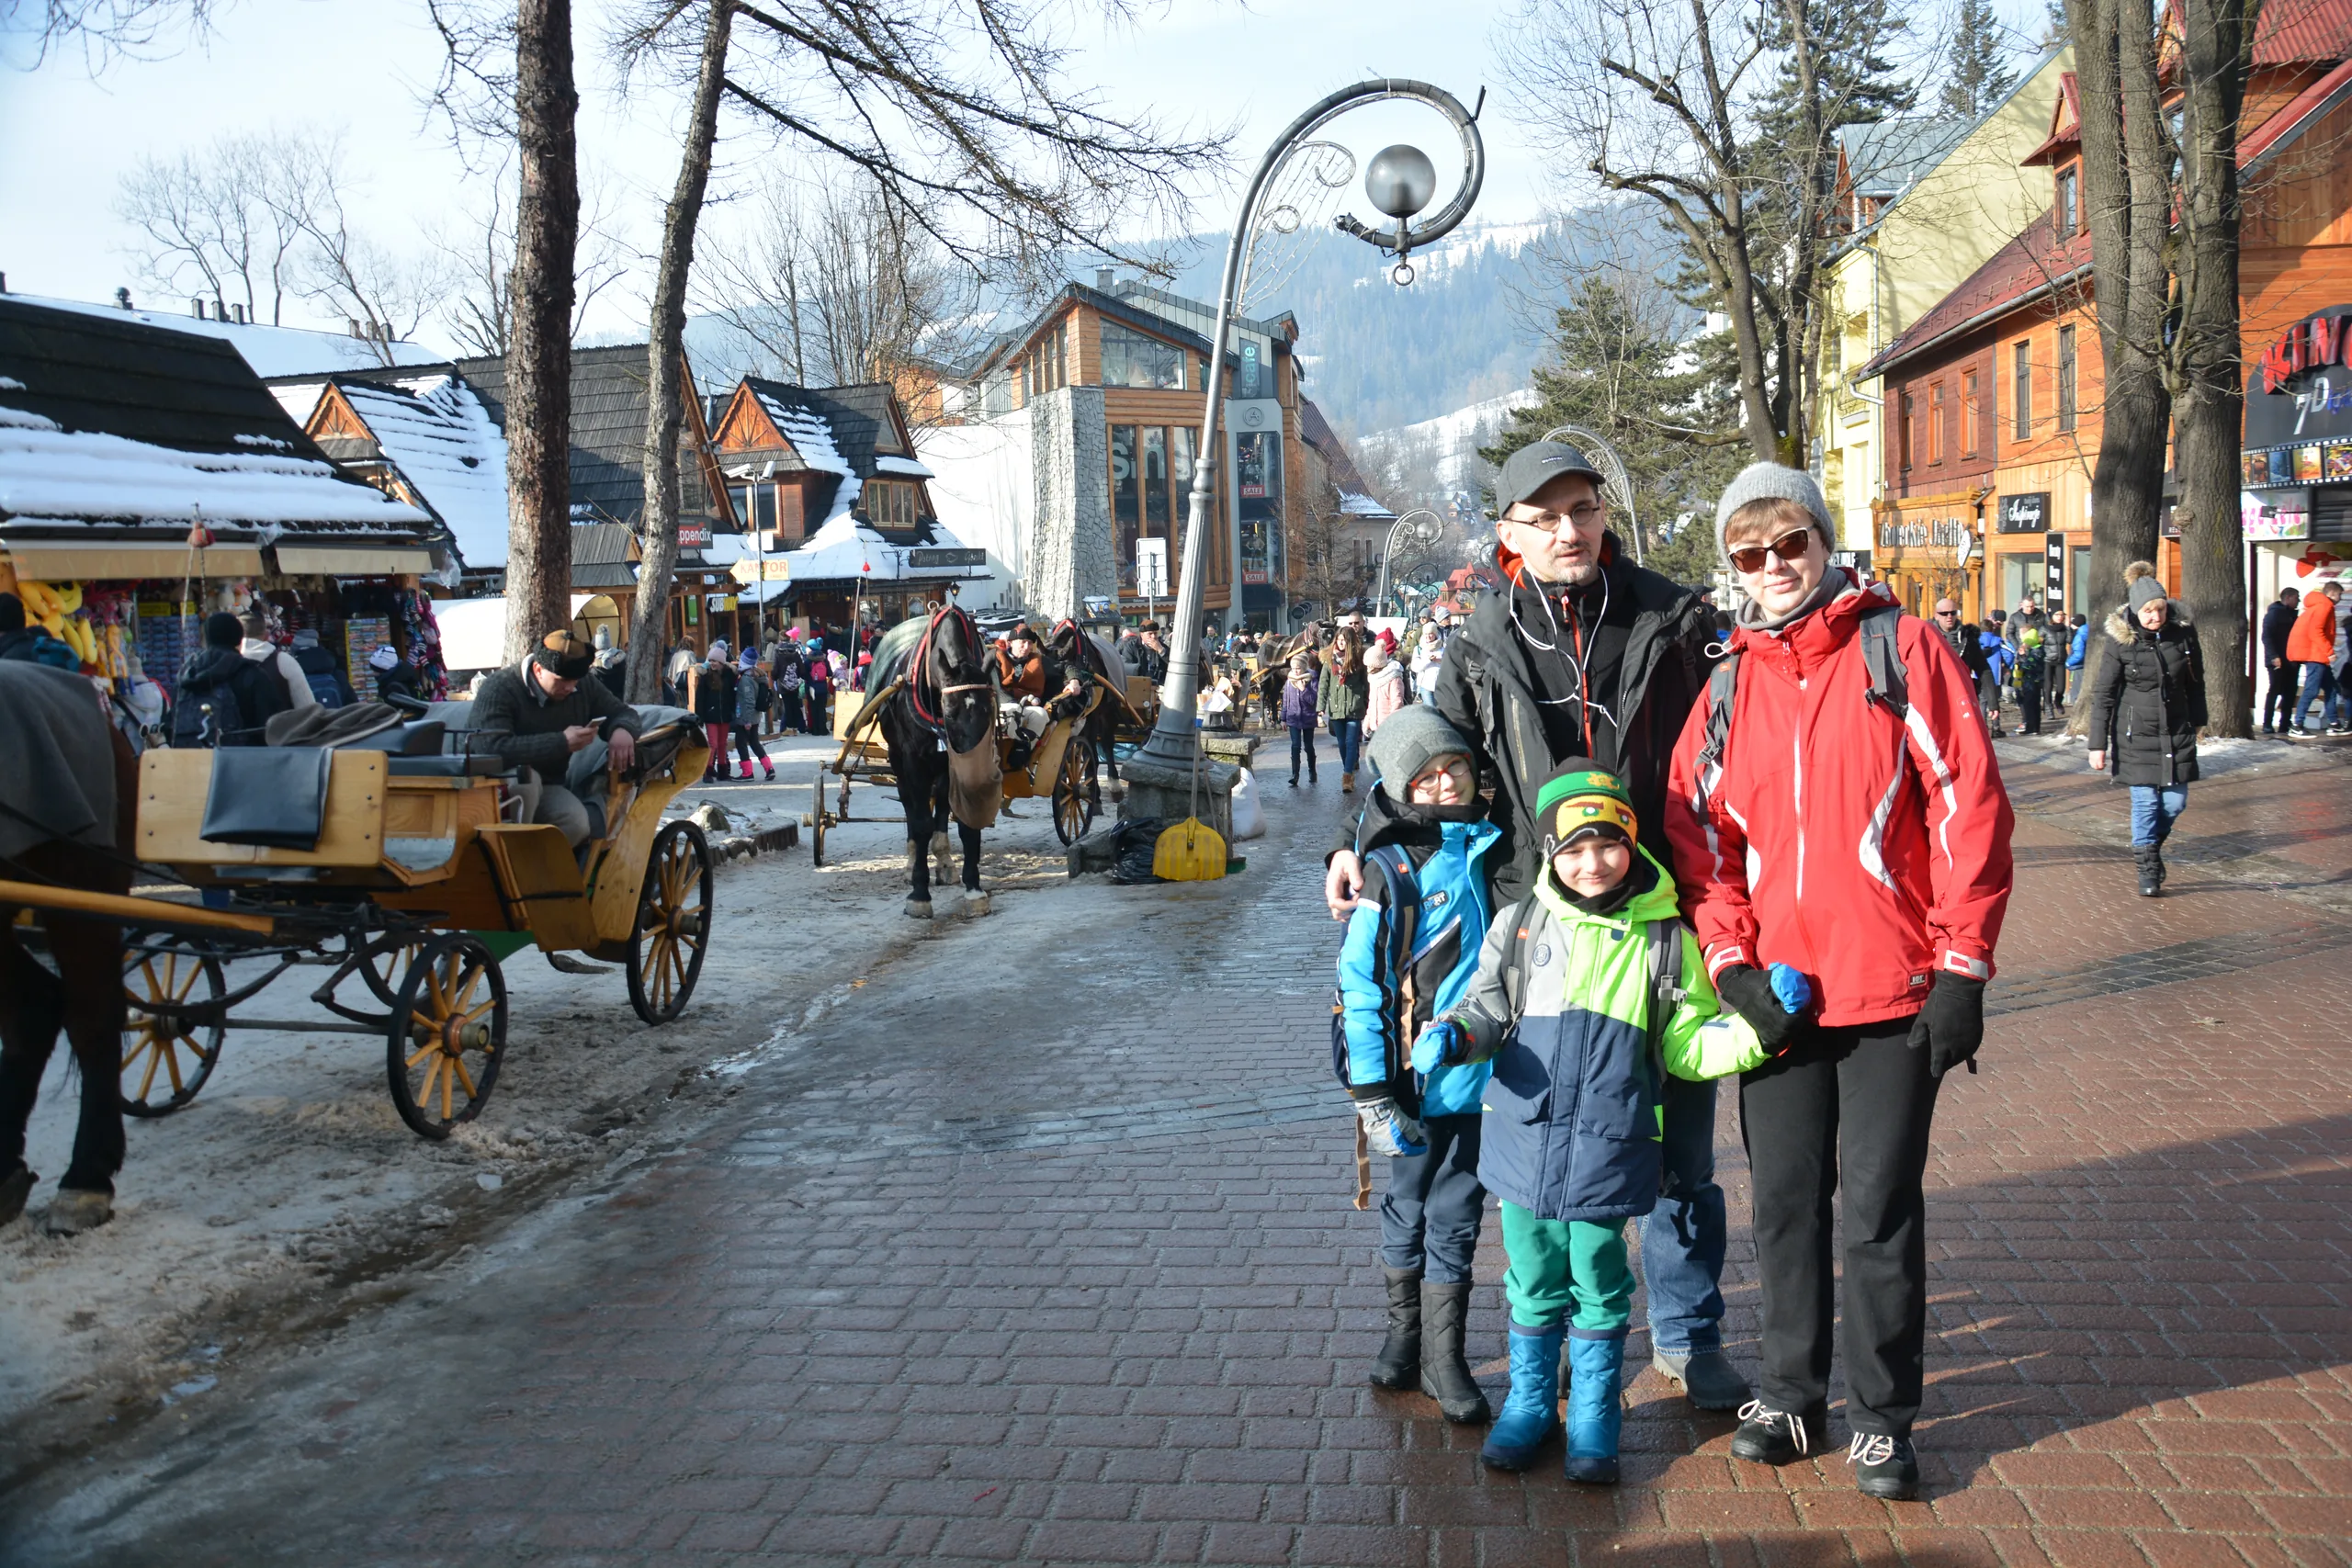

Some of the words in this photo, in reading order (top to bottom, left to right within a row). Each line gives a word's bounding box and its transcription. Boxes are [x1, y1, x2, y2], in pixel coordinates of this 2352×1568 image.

[678, 527, 711, 544] ppendix
[1247, 573, 1263, 581] SALE
[710, 596, 739, 613] SUBWAY
